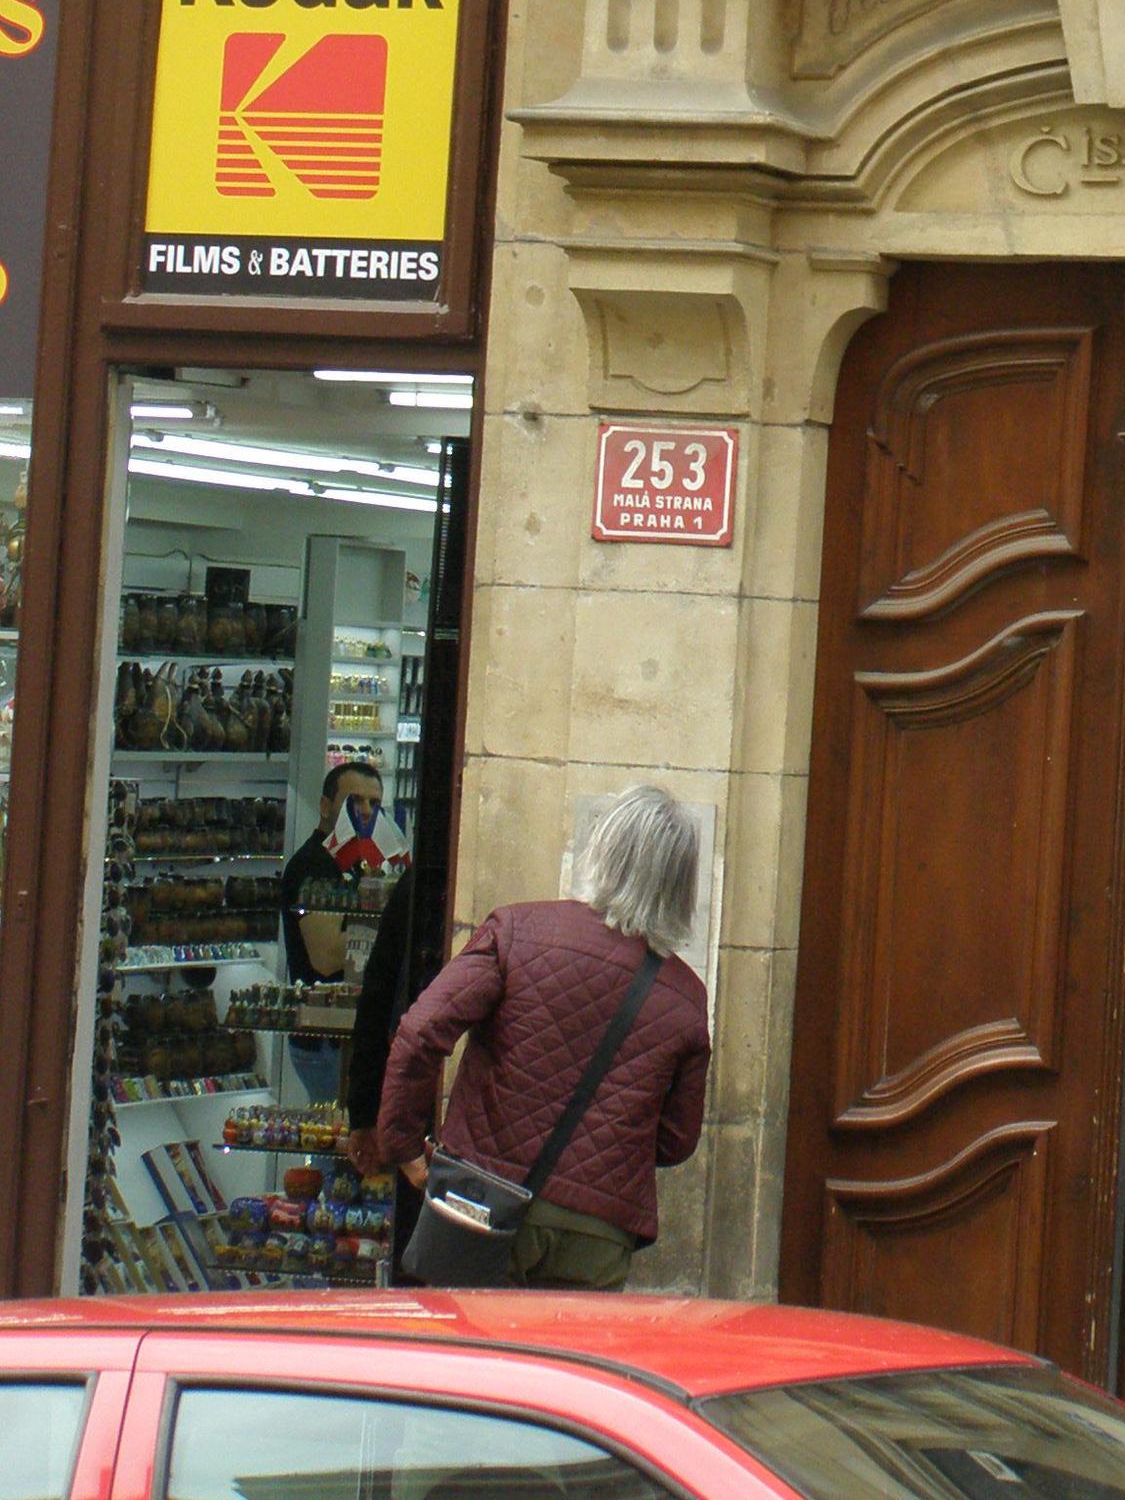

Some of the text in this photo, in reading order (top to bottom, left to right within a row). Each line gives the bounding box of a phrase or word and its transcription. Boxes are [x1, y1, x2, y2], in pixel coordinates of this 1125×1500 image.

[149, 244, 440, 281] FILMS & BATTERIES
[620, 439, 708, 491] 253
[613, 491, 713, 512] MALÁ STRANA
[619, 513, 703, 530] PRAHA 1
